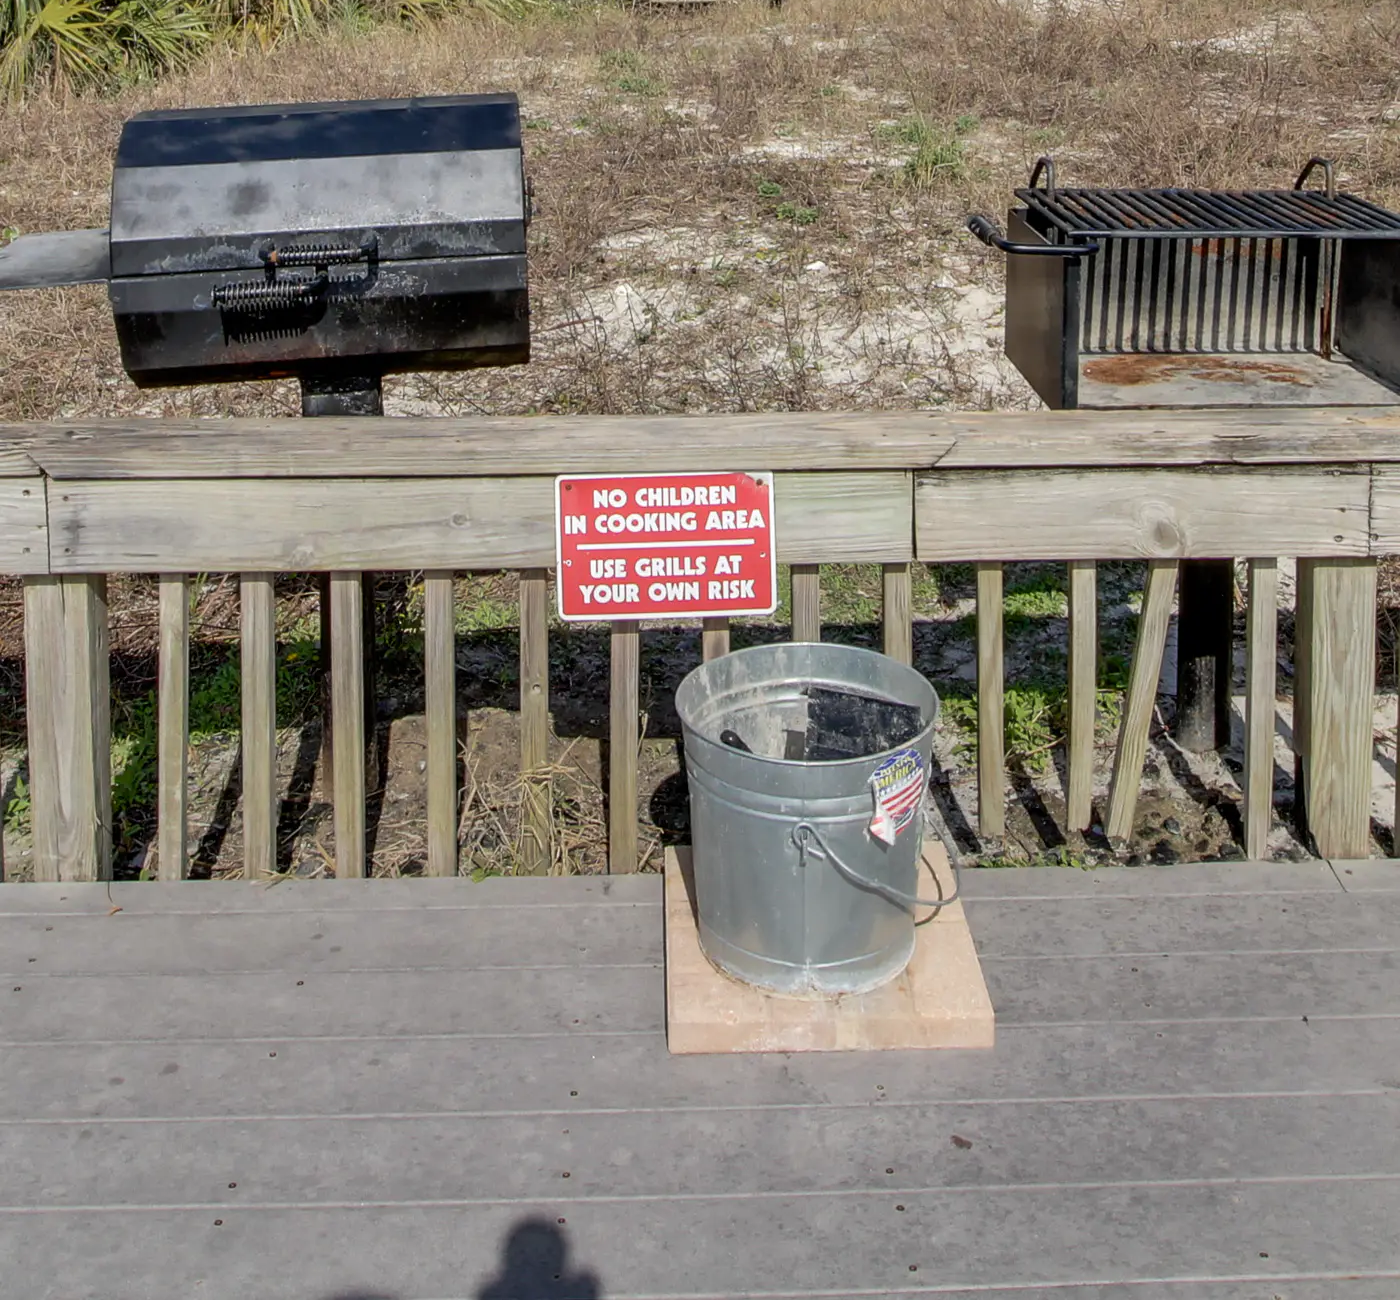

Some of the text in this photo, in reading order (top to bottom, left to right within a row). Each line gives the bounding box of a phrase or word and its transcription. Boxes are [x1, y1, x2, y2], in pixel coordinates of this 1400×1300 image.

[593, 484, 736, 509] NO CHILDREN
[564, 509, 766, 535] IN COOKING AREA
[590, 554, 742, 579] USE GRILLS AT
[579, 579, 755, 604] YOUR OWN RISK
